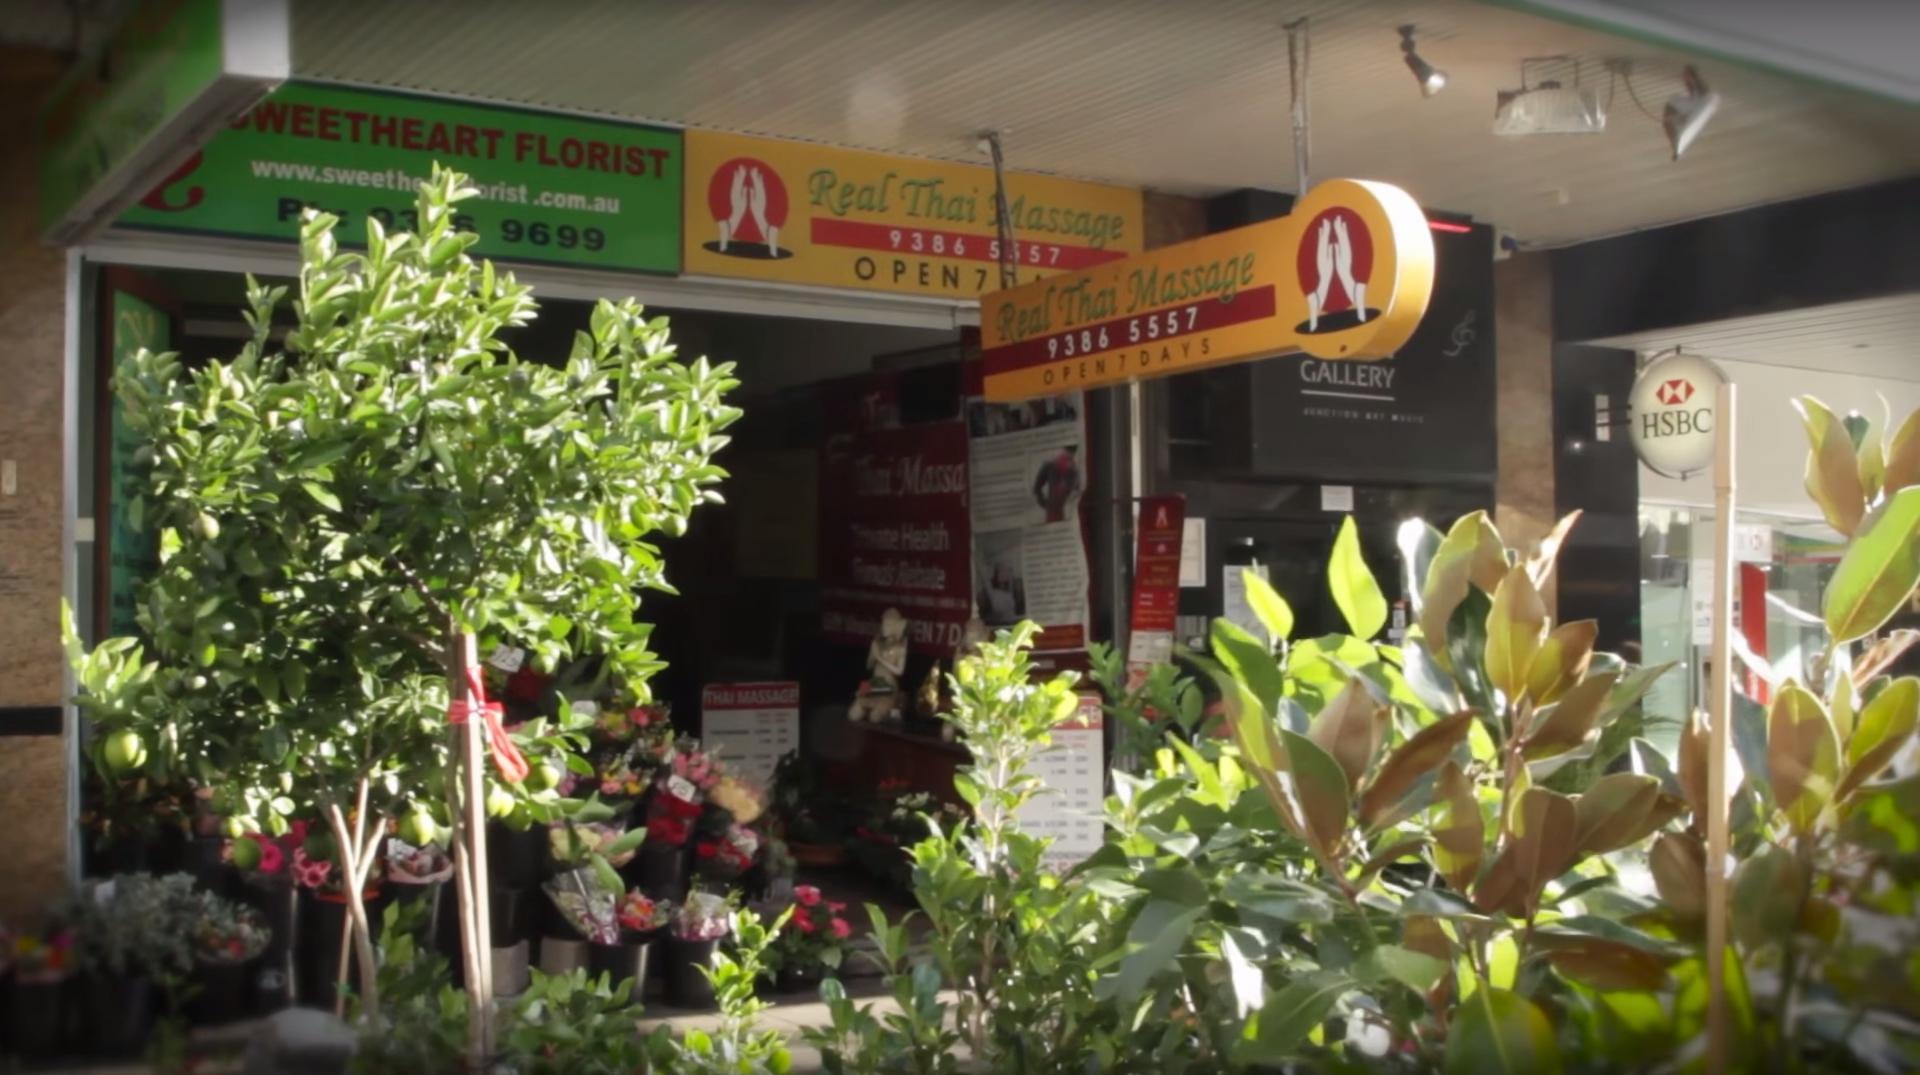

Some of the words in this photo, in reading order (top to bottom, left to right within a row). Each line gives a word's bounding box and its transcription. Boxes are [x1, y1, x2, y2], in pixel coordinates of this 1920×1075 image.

[515, 132, 670, 178] FLORIST
[808, 168, 897, 215] Real
[902, 177, 977, 222] Thai
[987, 192, 1125, 249] Massage
[500, 218, 606, 251] 9699
[889, 229, 965, 256] 9386
[854, 256, 960, 289] OPEN
[975, 268, 988, 291] 7
[997, 285, 1056, 342] Real
[1057, 274, 1118, 326] Thai
[1126, 251, 1256, 313] Massage
[1048, 327, 1109, 358] 9386
[1129, 306, 1198, 342] 5557
[1043, 359, 1105, 385] OPEN
[1118, 354, 1127, 366] 7
[1139, 337, 1211, 366] DAYS
[1300, 360, 1395, 388] GALLERY
[1640, 408, 1713, 439] HSBC
[736, 688, 798, 704] MASSAGE
